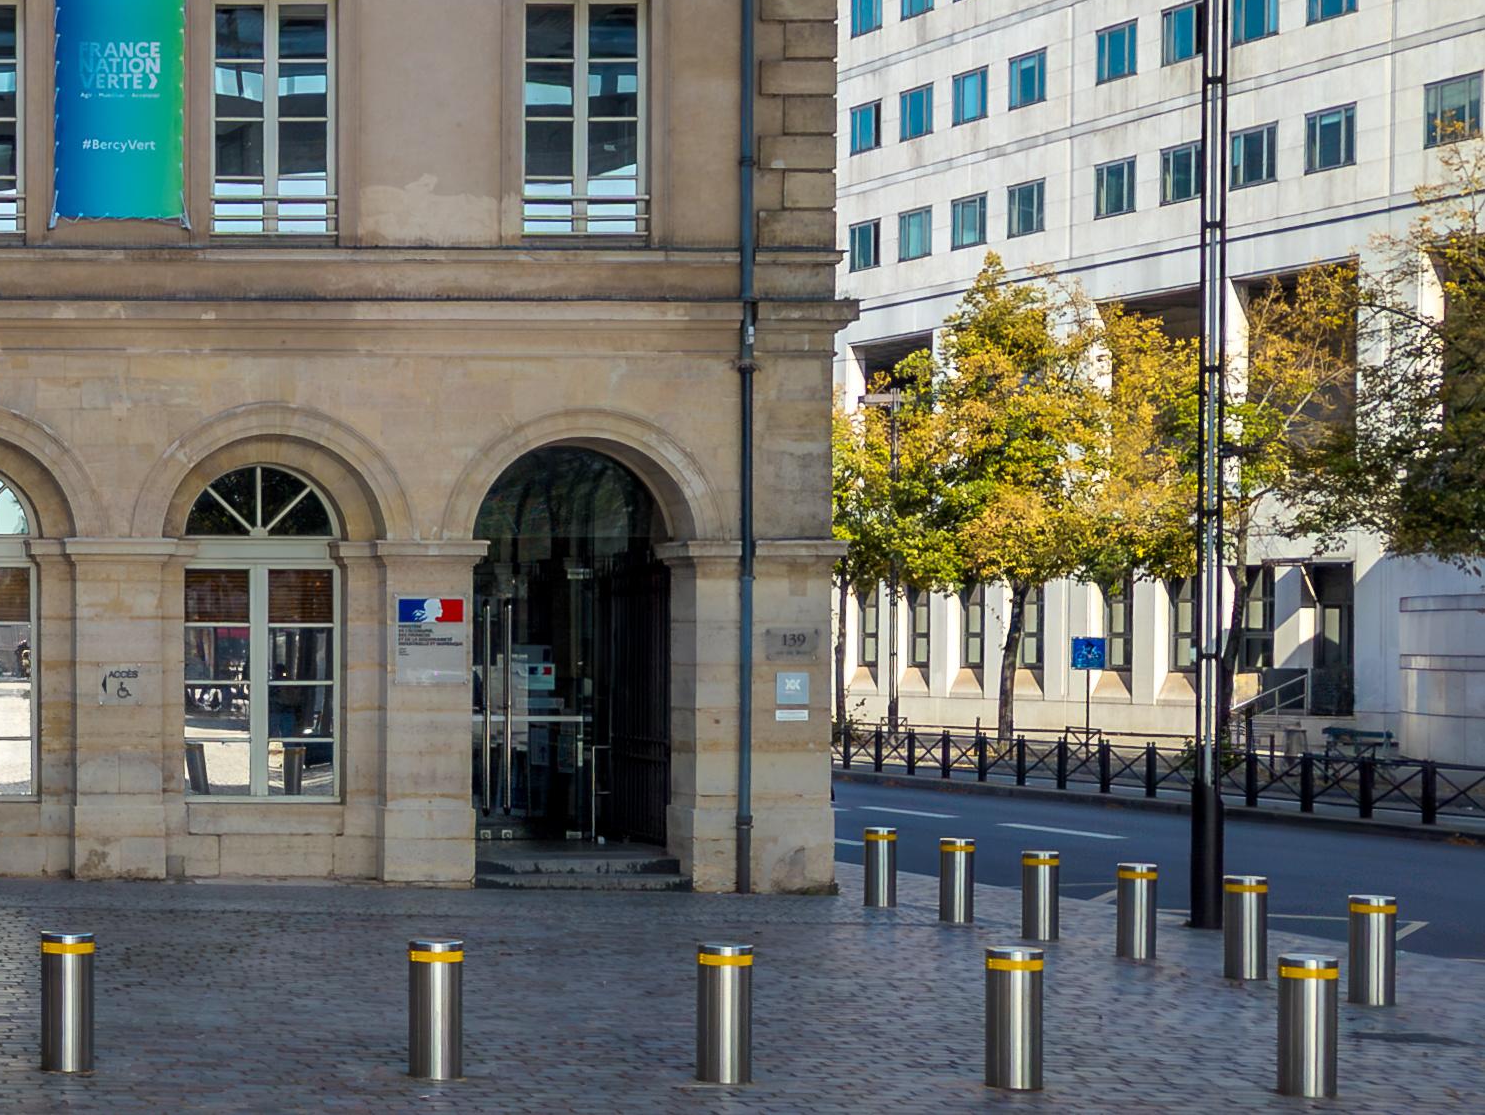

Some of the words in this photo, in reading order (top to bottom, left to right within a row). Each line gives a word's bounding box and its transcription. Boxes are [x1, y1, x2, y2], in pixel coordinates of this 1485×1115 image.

[79, 42, 161, 58] FRANCE
[79, 58, 161, 73] NATION
[80, 73, 143, 89] VERTE
[82, 139, 156, 152] #BercyVert
[782, 633, 806, 647] 139
[108, 669, 139, 678] ACCÈS
